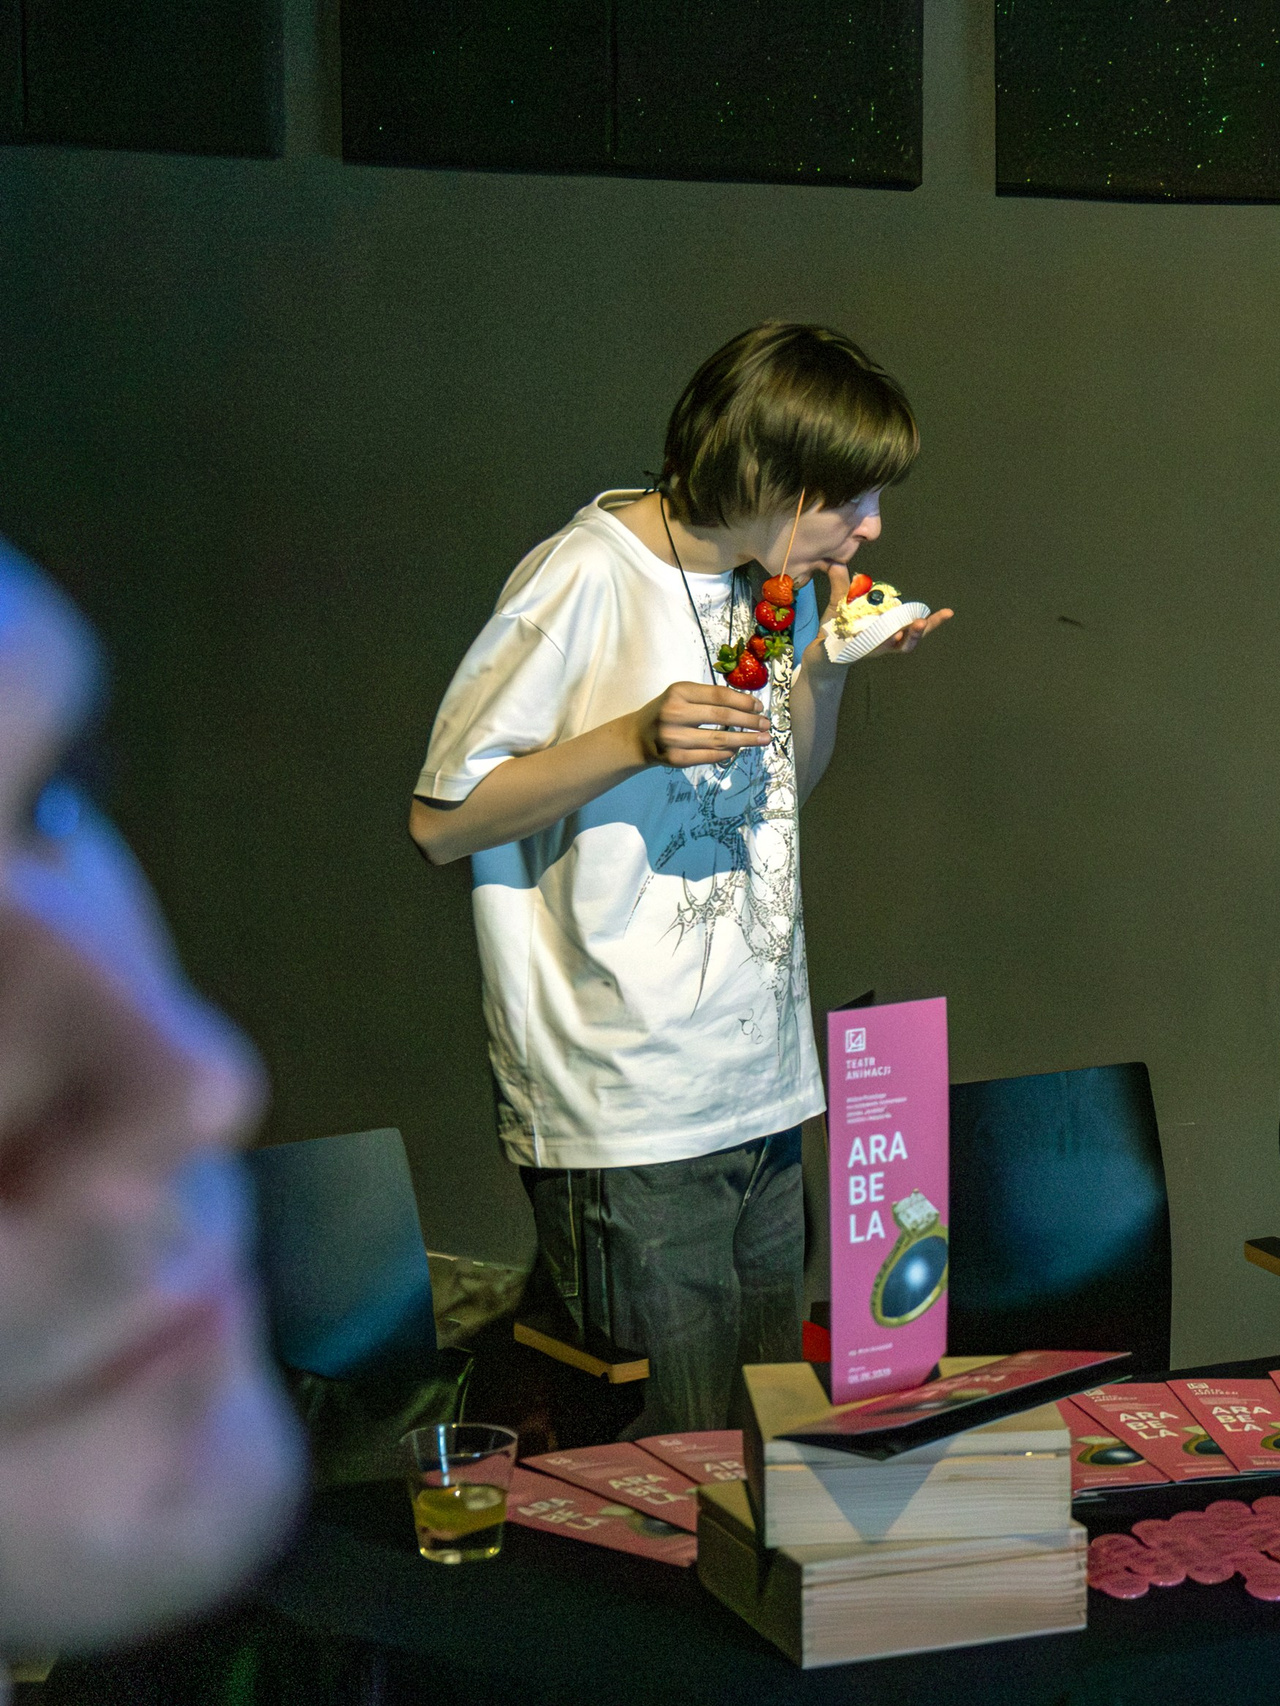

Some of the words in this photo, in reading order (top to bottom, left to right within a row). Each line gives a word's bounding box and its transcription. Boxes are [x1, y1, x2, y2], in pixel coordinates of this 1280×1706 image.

[847, 1131, 908, 1168] ARA
[849, 1171, 885, 1205] BE
[850, 1210, 885, 1244] LA
[1211, 1406, 1272, 1415] ARA
[1119, 1411, 1179, 1423] ARA
[1215, 1414, 1255, 1423] BE
[1126, 1420, 1167, 1430] BE
[1223, 1423, 1264, 1432] LA
[1137, 1428, 1180, 1440] LA
